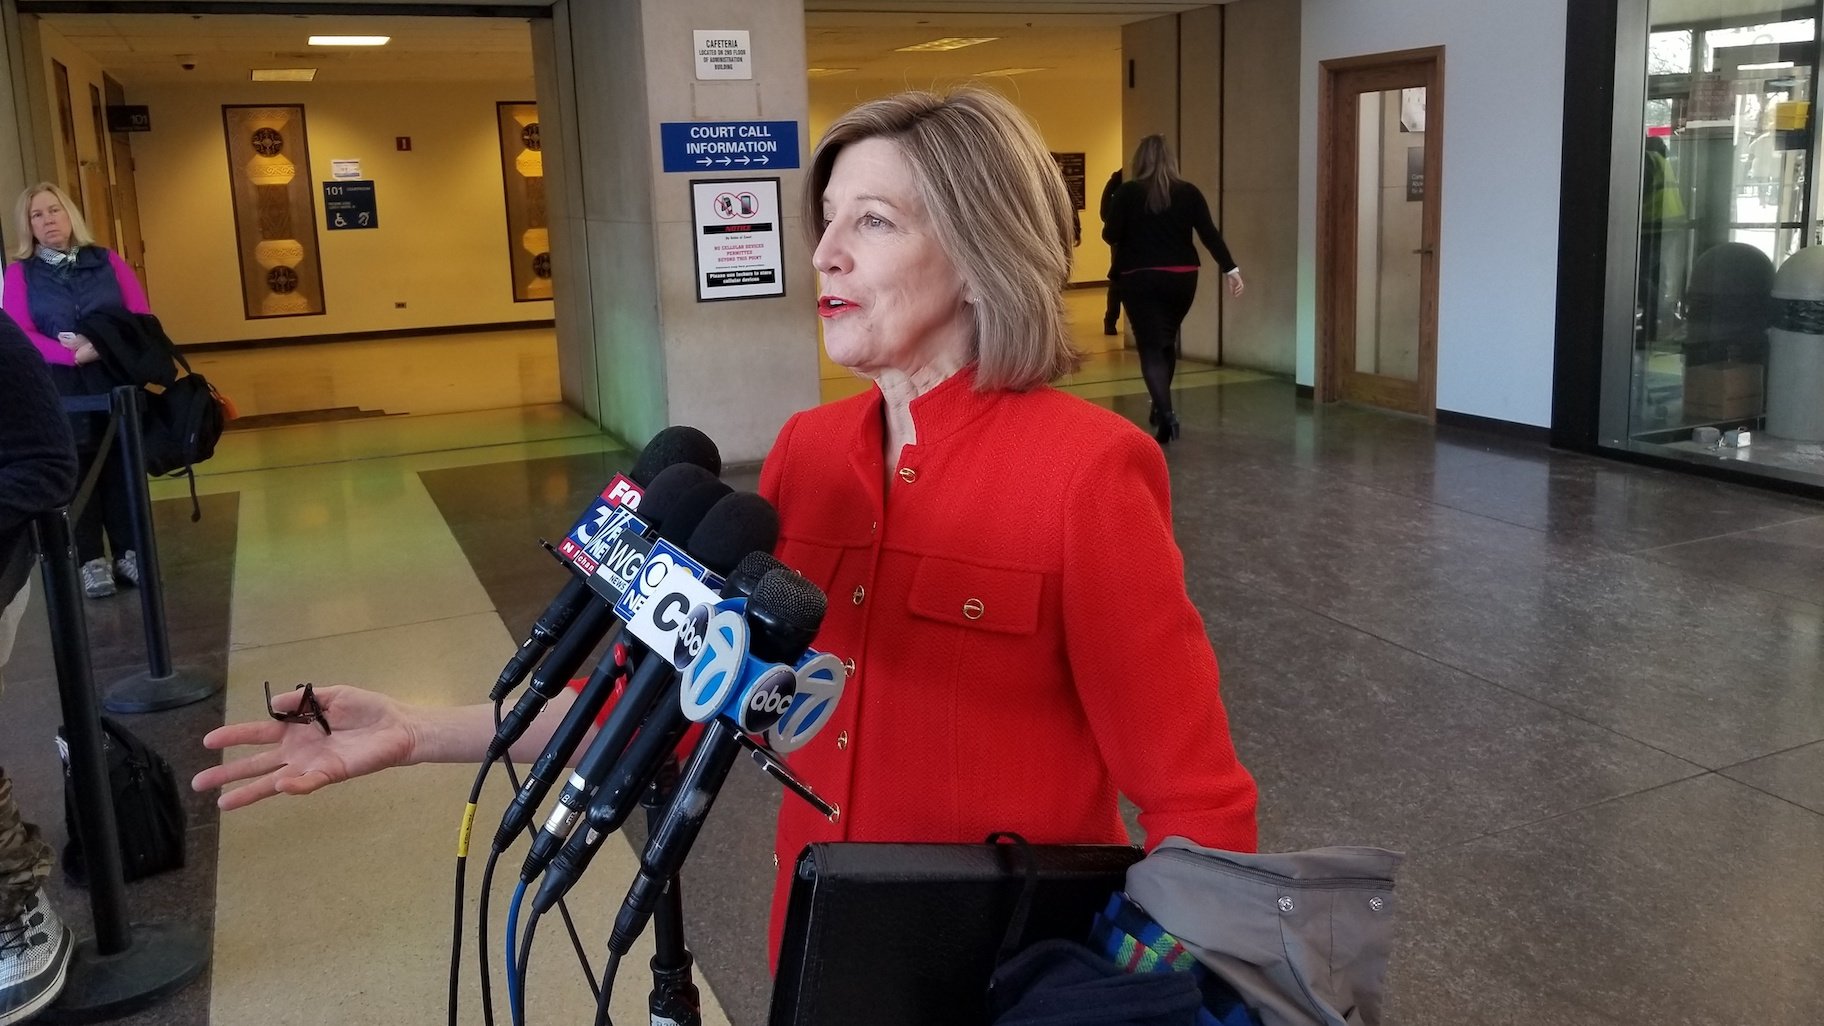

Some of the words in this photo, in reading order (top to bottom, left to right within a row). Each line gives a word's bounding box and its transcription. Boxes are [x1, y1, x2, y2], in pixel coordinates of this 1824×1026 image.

[706, 40, 738, 48] CAFETERIA
[130, 114, 148, 125] 101
[690, 126, 736, 138] COURT
[738, 125, 771, 138] CALL
[686, 140, 777, 154] INFORMATION
[326, 186, 343, 195] 101
[608, 480, 642, 512] FO
[608, 575, 627, 591] NEWS
[679, 617, 702, 656] abc
[750, 685, 794, 714] abc
